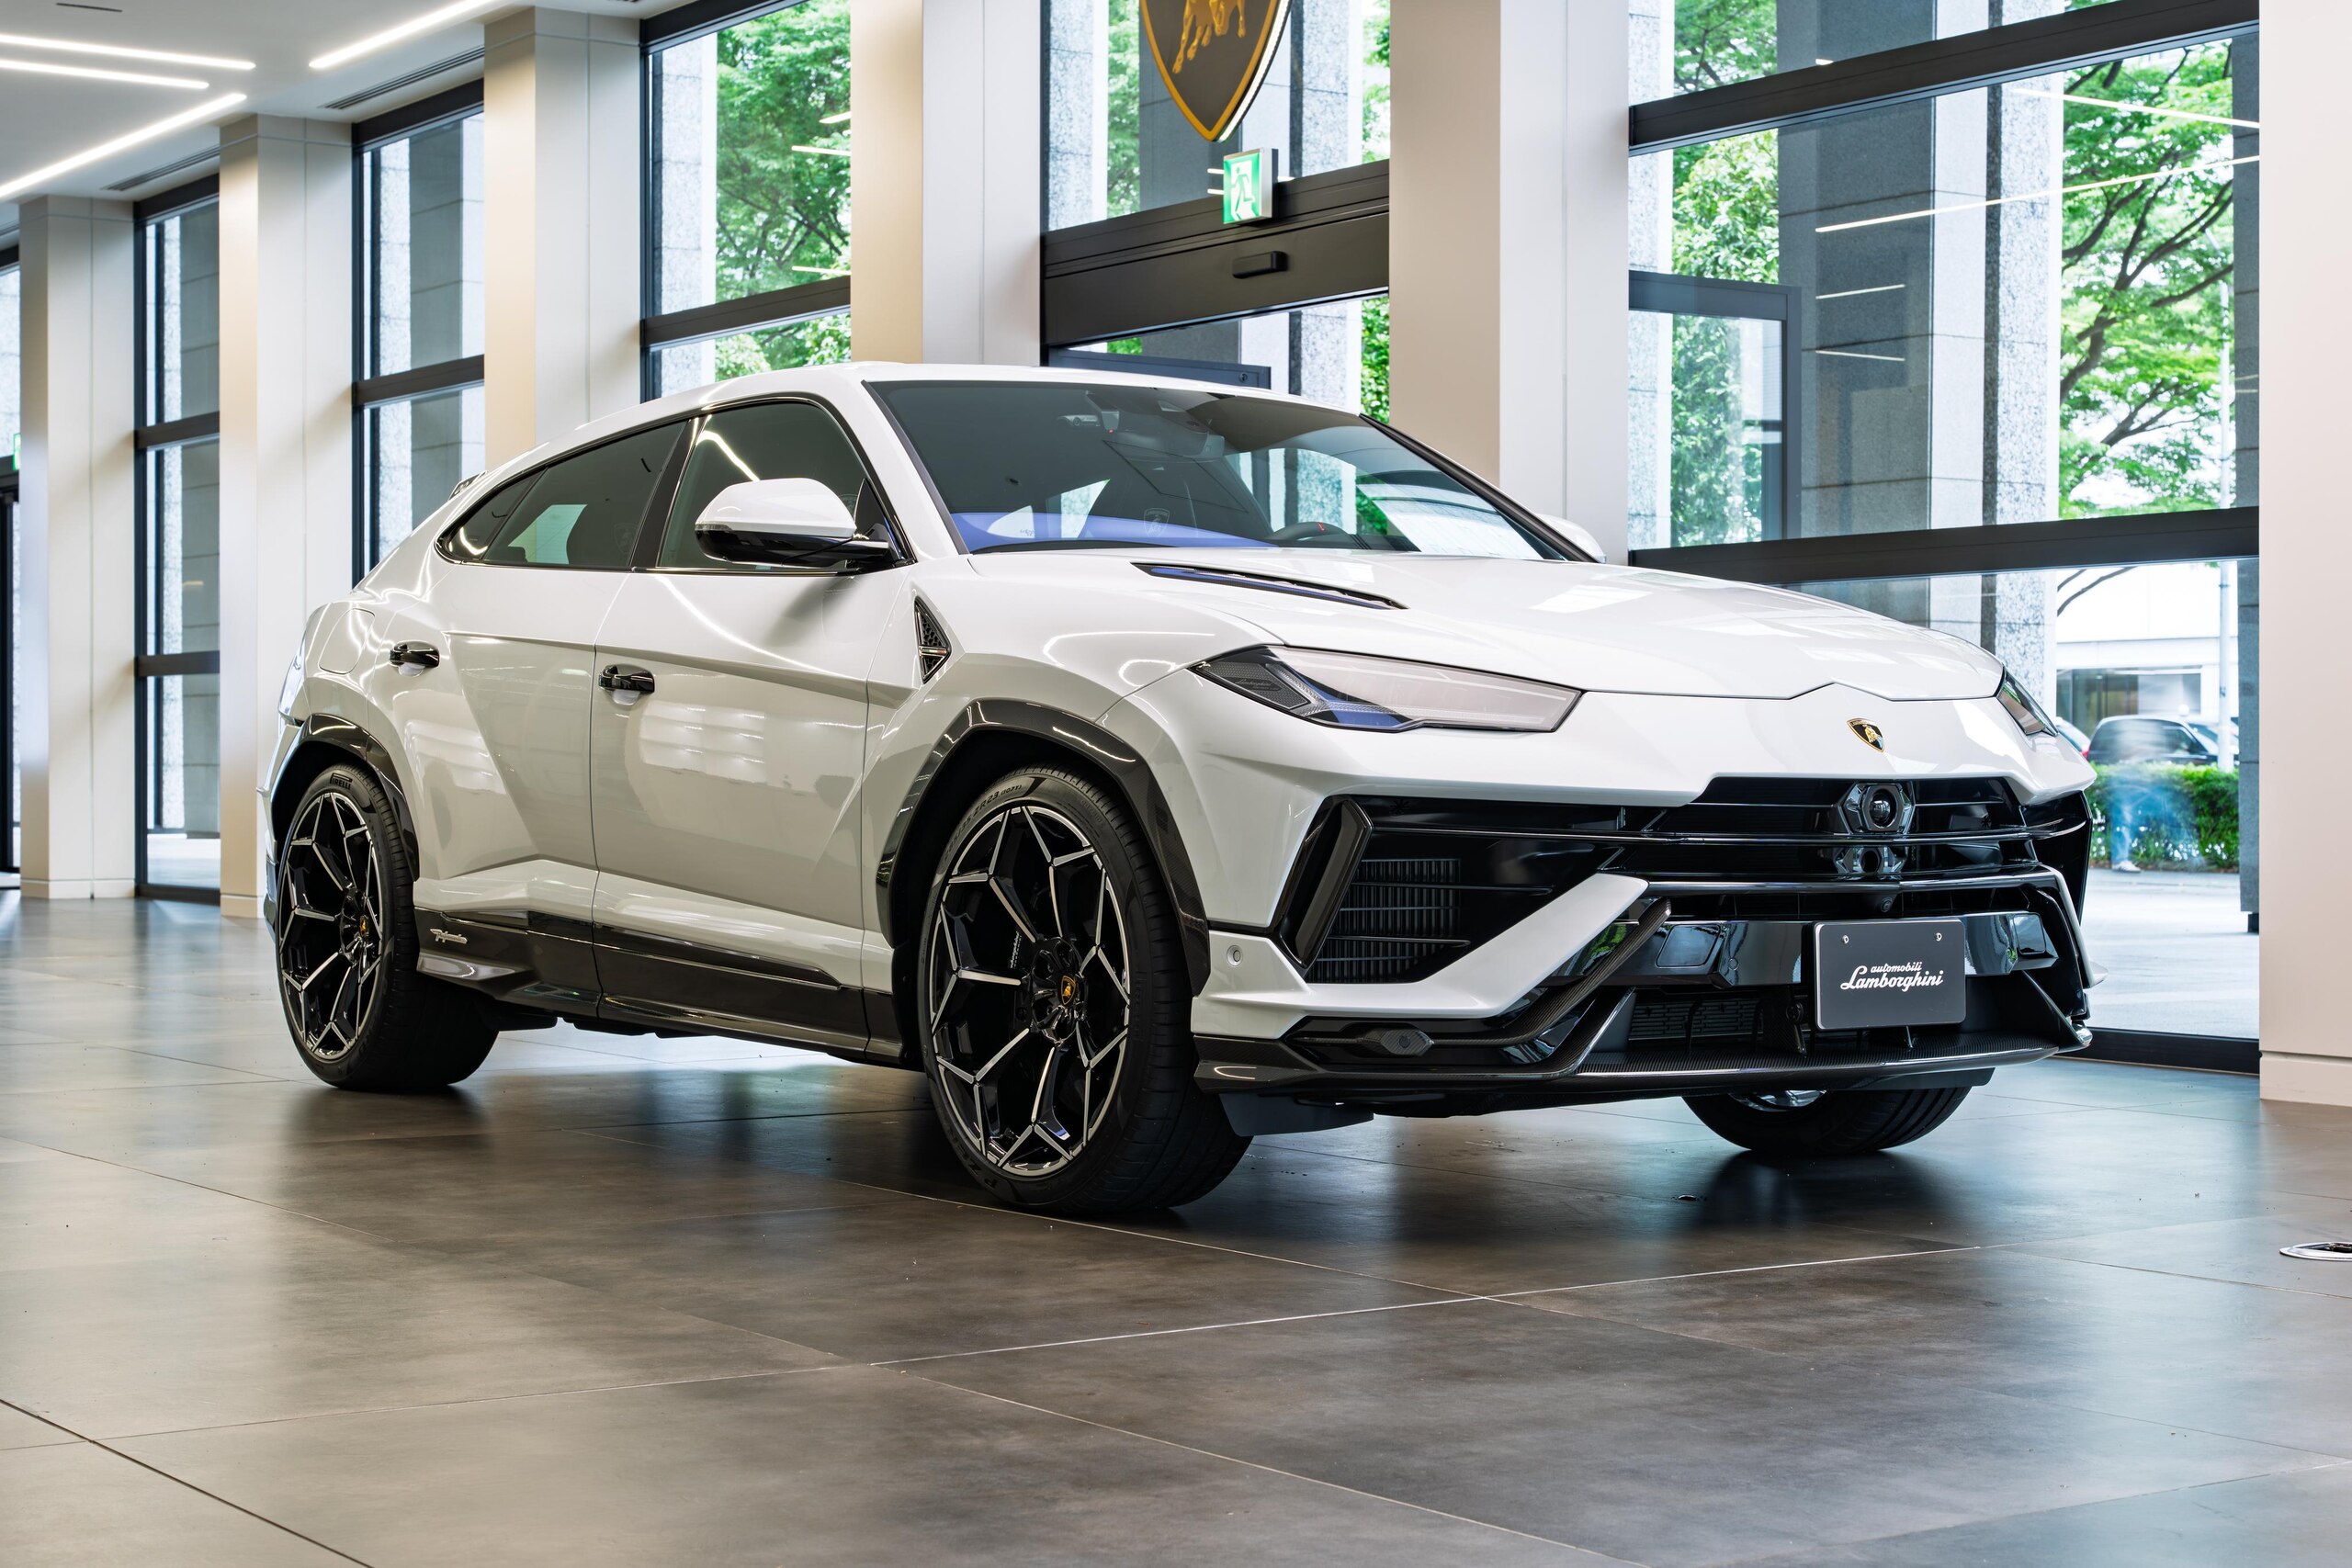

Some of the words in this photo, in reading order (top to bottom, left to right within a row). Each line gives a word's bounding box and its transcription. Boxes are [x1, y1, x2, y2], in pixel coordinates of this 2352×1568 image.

[330, 773, 353, 790] PIRELLI
[973, 791, 1000, 817] ZR23
[1870, 961, 1922, 974] automobili
[1840, 965, 1944, 992] Lamborghini
